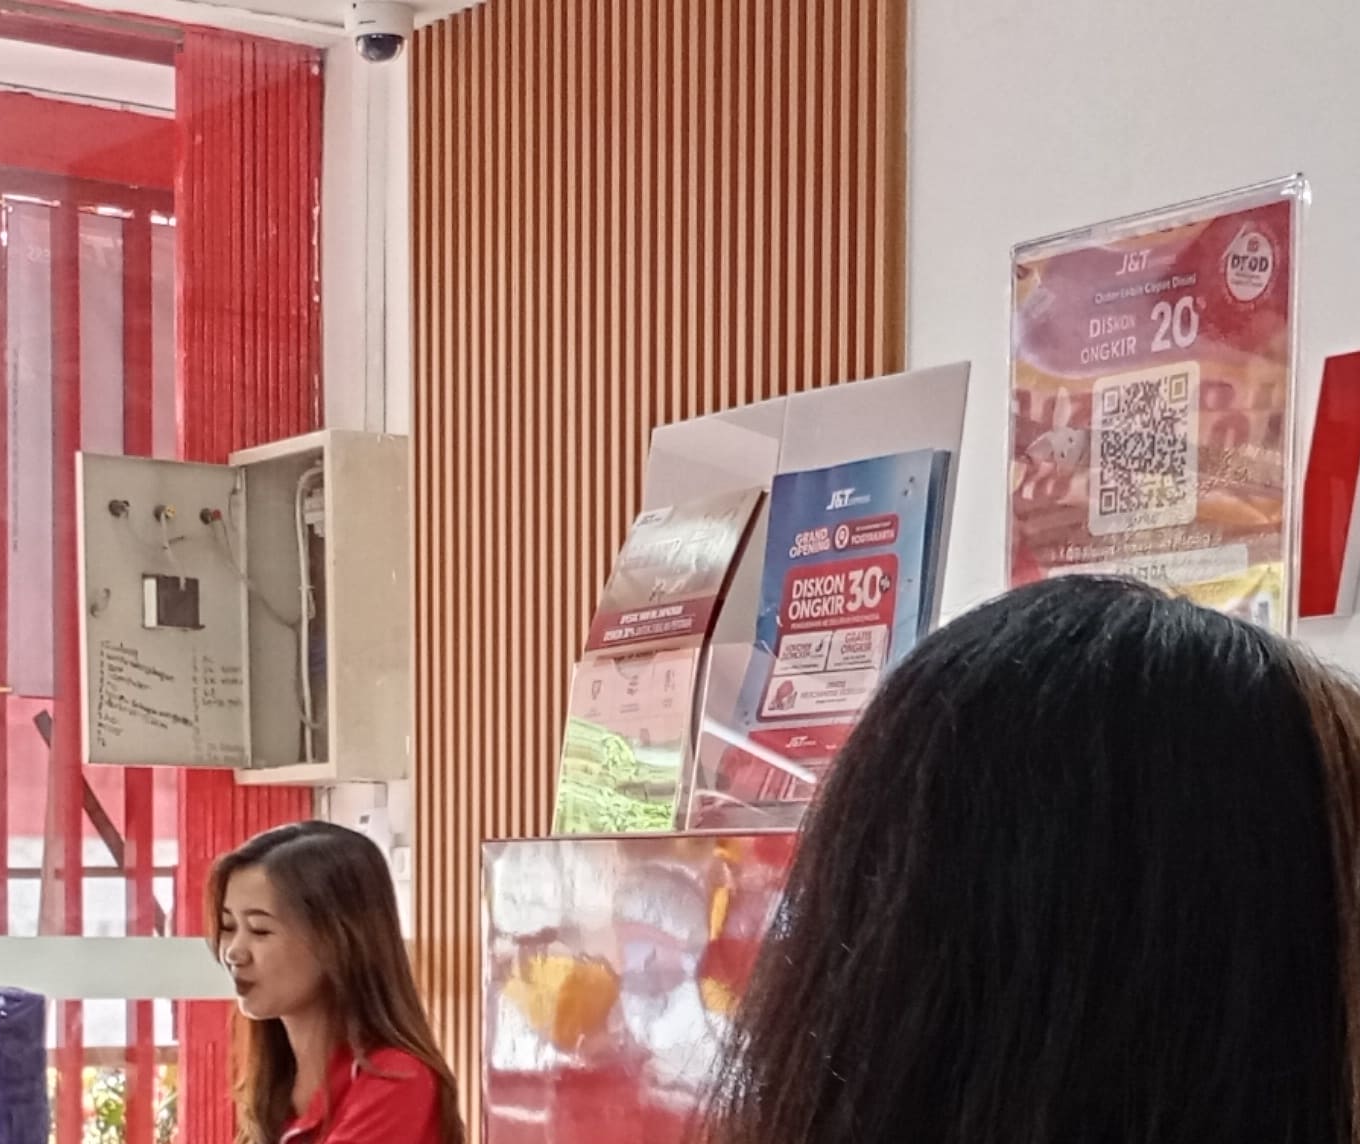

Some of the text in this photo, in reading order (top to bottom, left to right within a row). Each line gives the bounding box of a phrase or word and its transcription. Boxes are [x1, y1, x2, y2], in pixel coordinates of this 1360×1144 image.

[1115, 249, 1153, 276] J&T
[1089, 314, 1136, 339] DISKON
[1081, 336, 1137, 365] ONGKIR
[825, 488, 856, 511] J&T
[792, 573, 846, 600] DISKON
[788, 595, 846, 621] ONGKIR
